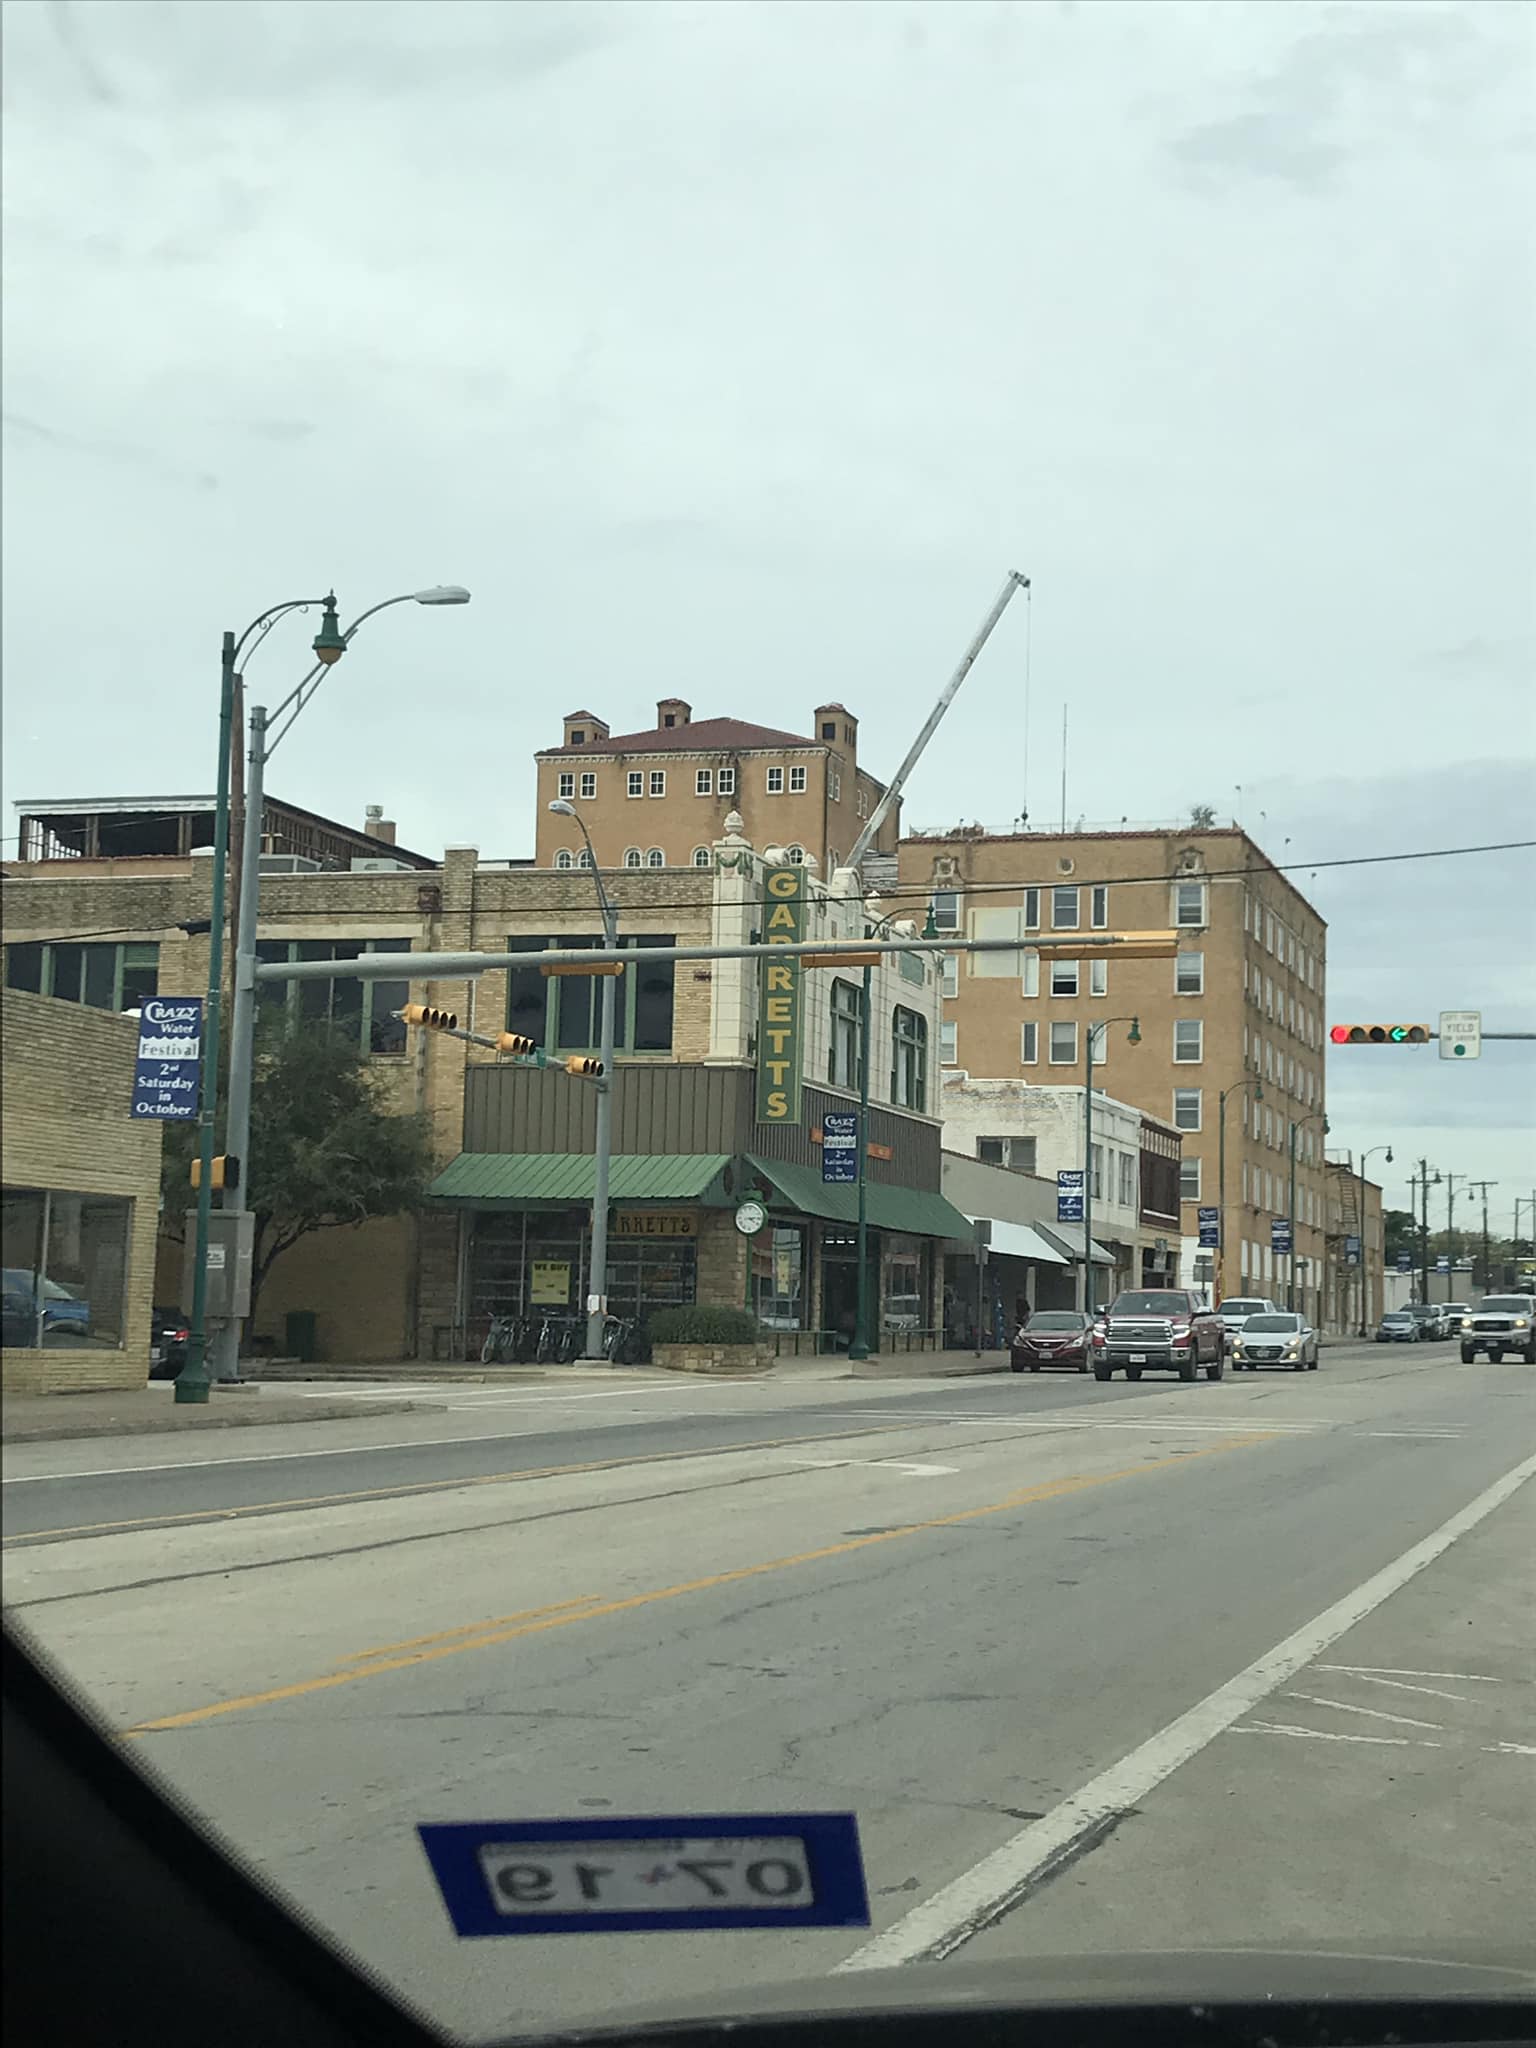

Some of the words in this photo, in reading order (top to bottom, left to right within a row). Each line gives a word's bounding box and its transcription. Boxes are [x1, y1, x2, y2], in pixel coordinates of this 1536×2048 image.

[766, 872, 798, 1118] GARRETTS
[145, 1002, 199, 1024] CRAZY
[161, 1024, 194, 1034] Water
[142, 1043, 197, 1056] Festival
[138, 1076, 194, 1092] Saturday
[159, 1090, 172, 1101] in
[136, 1102, 192, 1115] October
[620, 1216, 690, 1233] RRETTS
